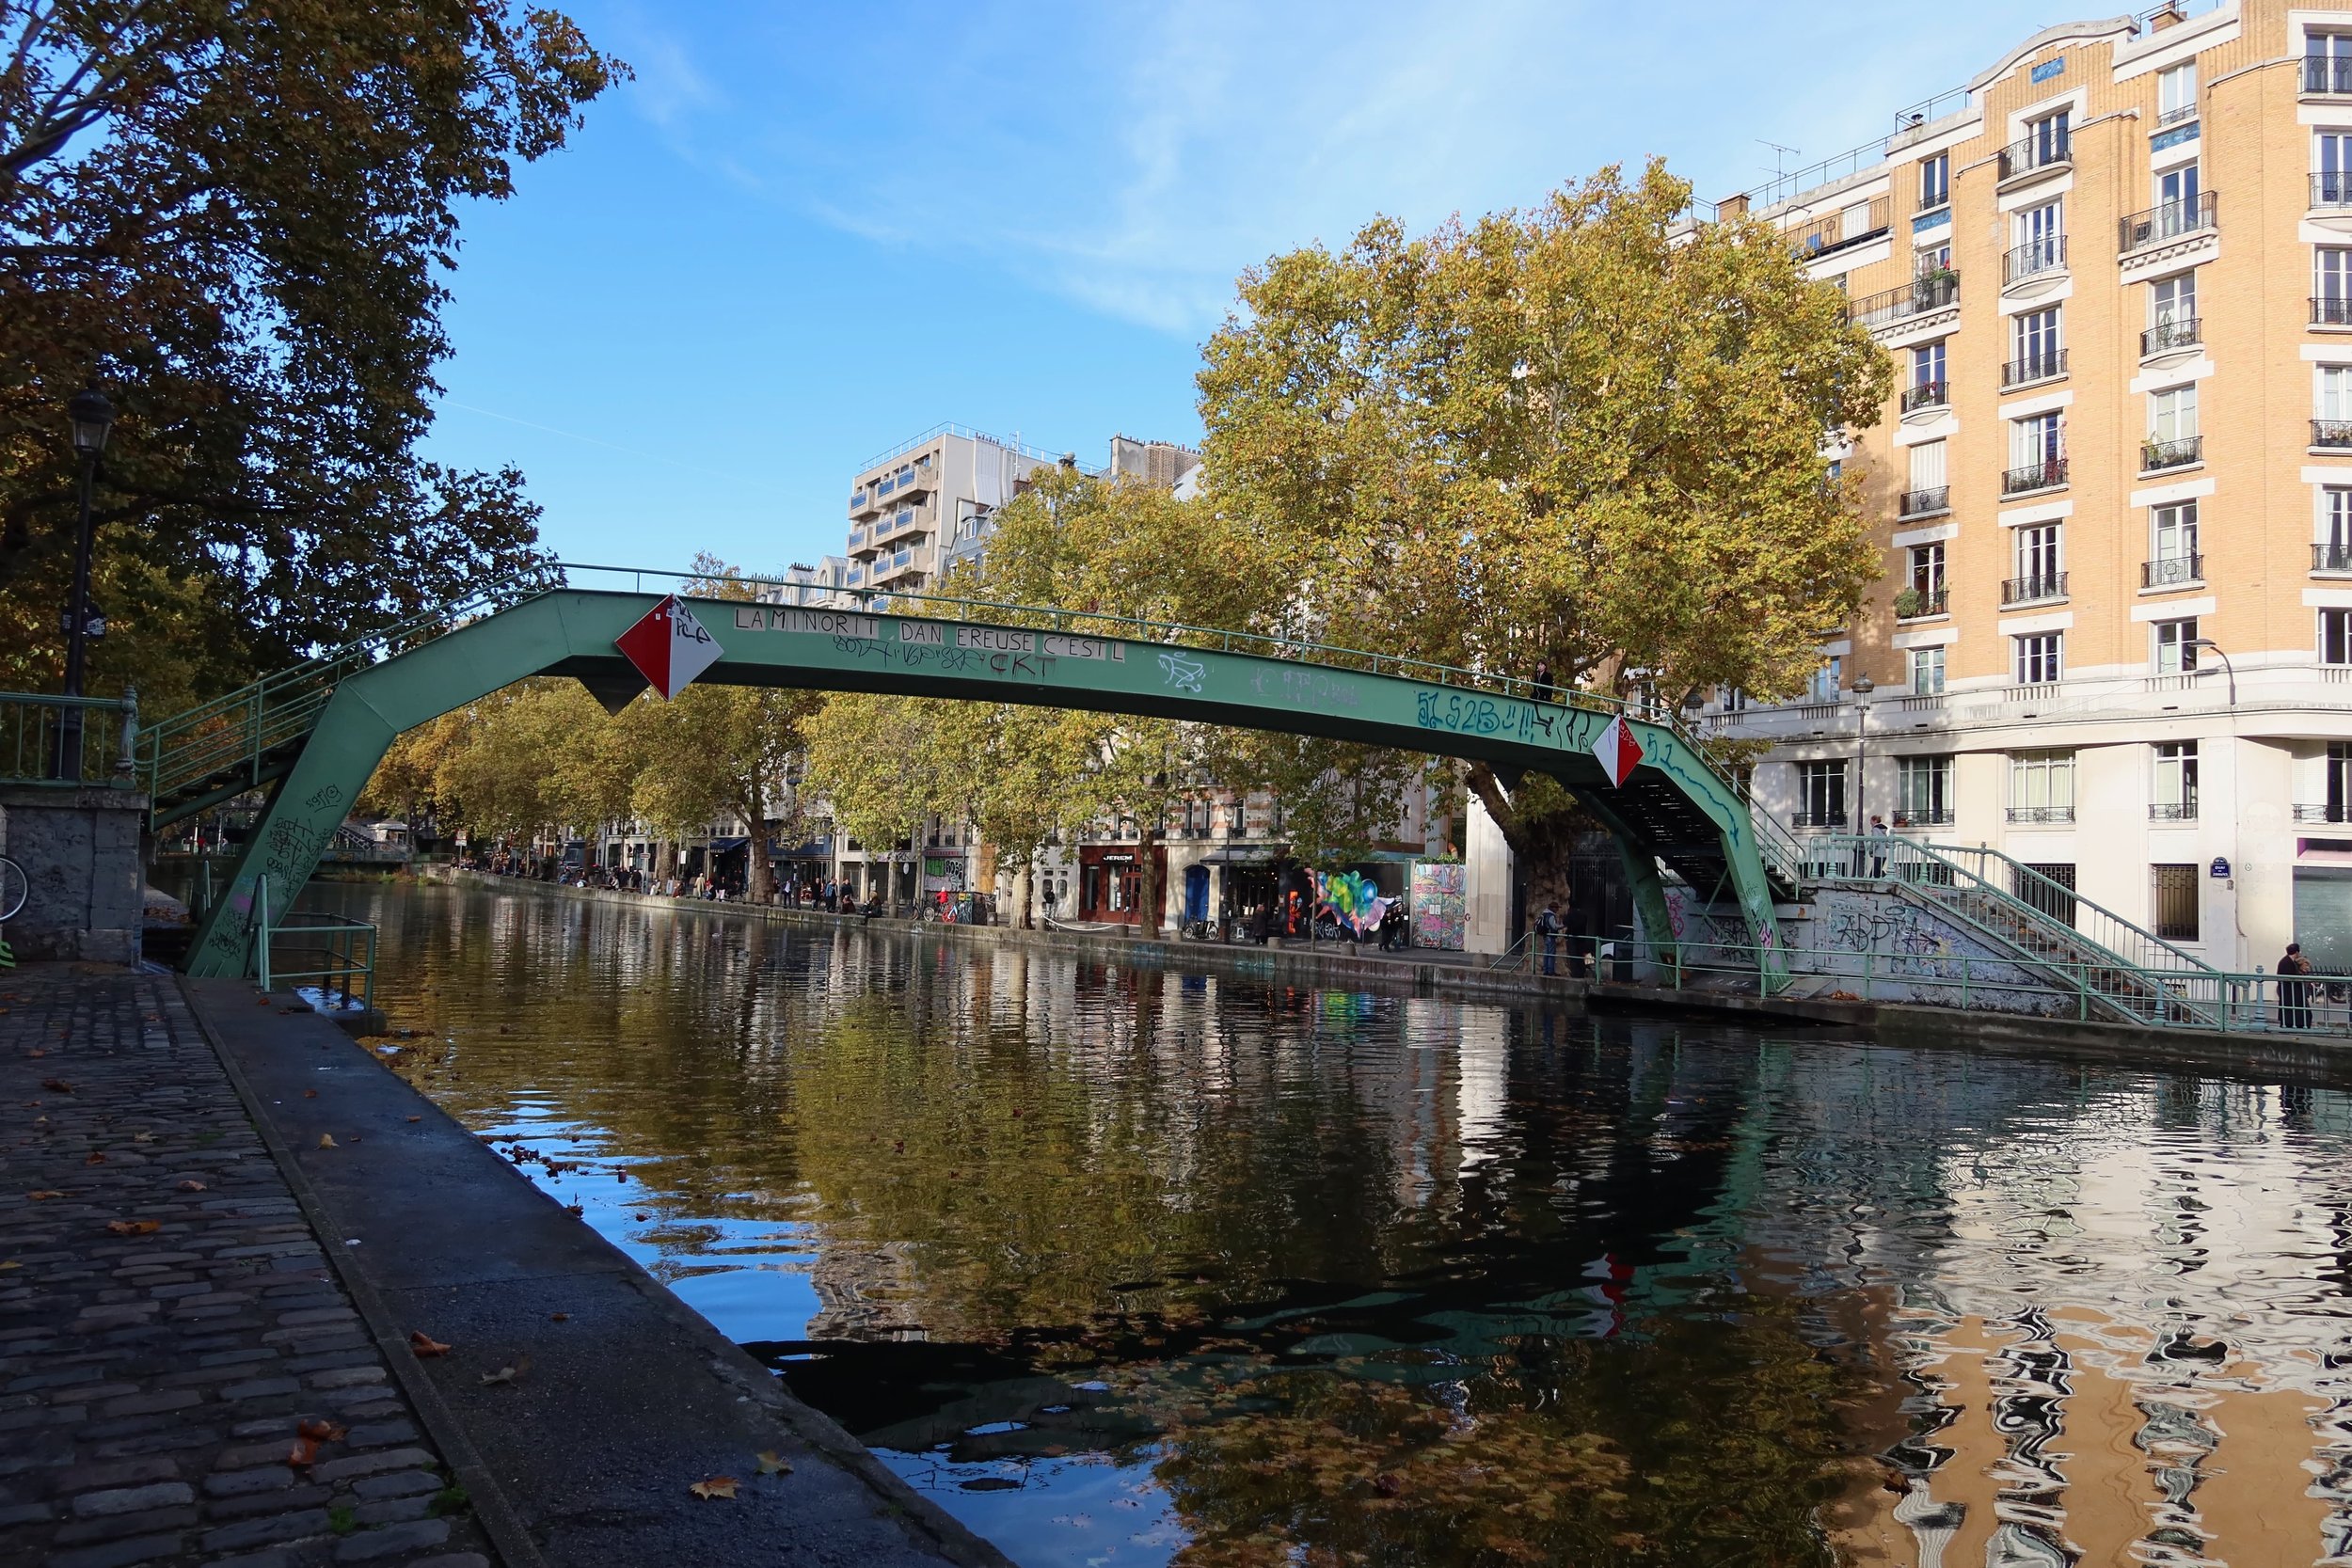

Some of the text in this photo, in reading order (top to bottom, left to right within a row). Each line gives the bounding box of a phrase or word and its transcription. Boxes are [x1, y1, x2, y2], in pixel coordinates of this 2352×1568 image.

[735, 609, 764, 629] LA
[771, 609, 879, 637] MINORIT
[900, 622, 942, 643] DAN
[957, 627, 1033, 652] EREUSE
[1043, 636, 1106, 657] C'EST
